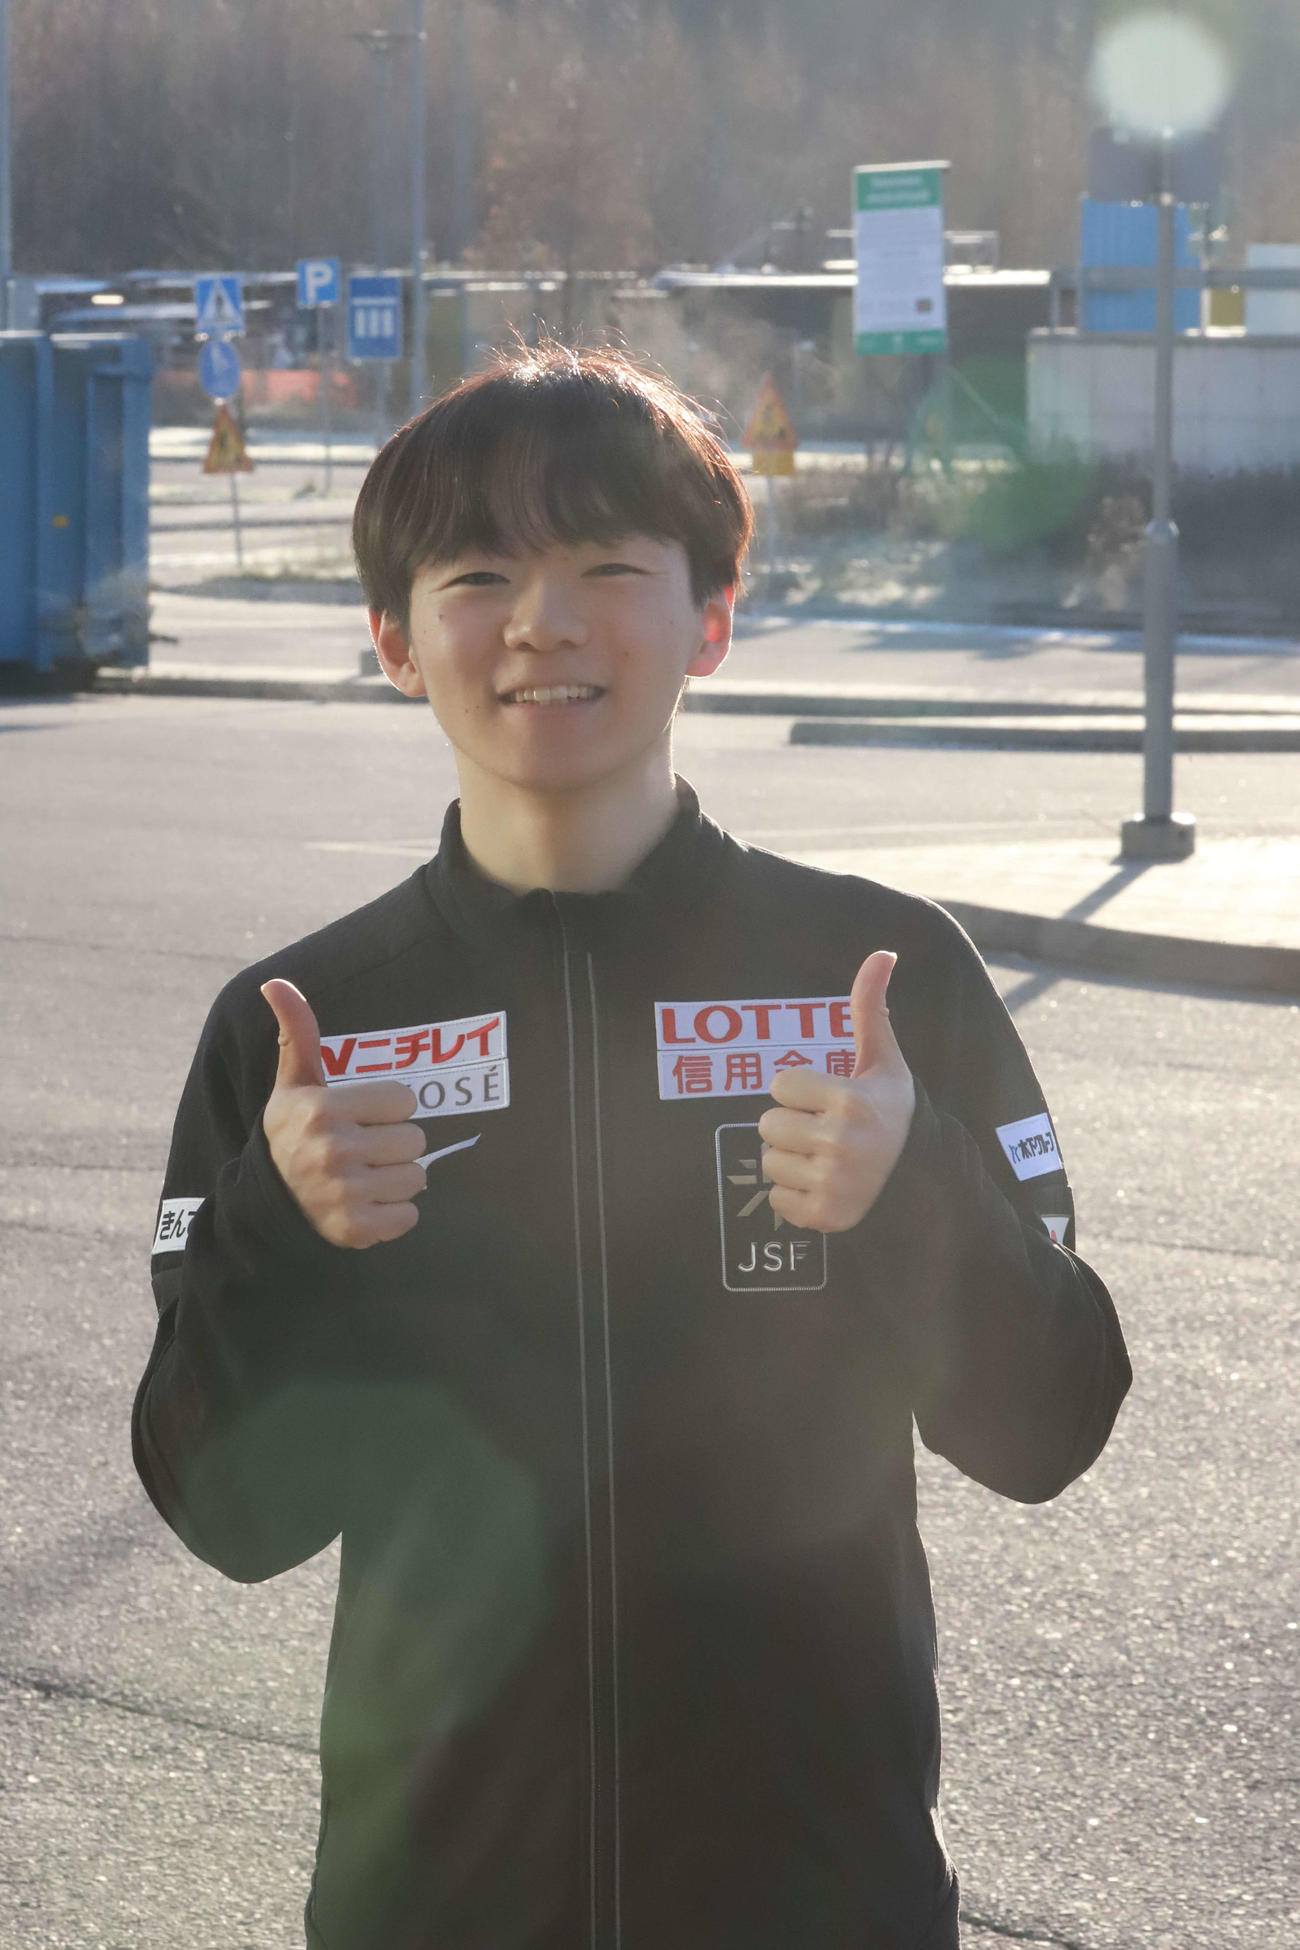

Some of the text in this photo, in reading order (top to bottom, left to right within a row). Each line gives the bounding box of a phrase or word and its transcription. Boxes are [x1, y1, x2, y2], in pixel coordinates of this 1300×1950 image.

[305, 261, 334, 308] P
[662, 1002, 854, 1044] LOTTE
[355, 1017, 500, 1074] ニチレイ
[407, 1065, 500, 1110] OSÉ
[160, 1209, 198, 1240] きん
[737, 1240, 812, 1272] JSF
